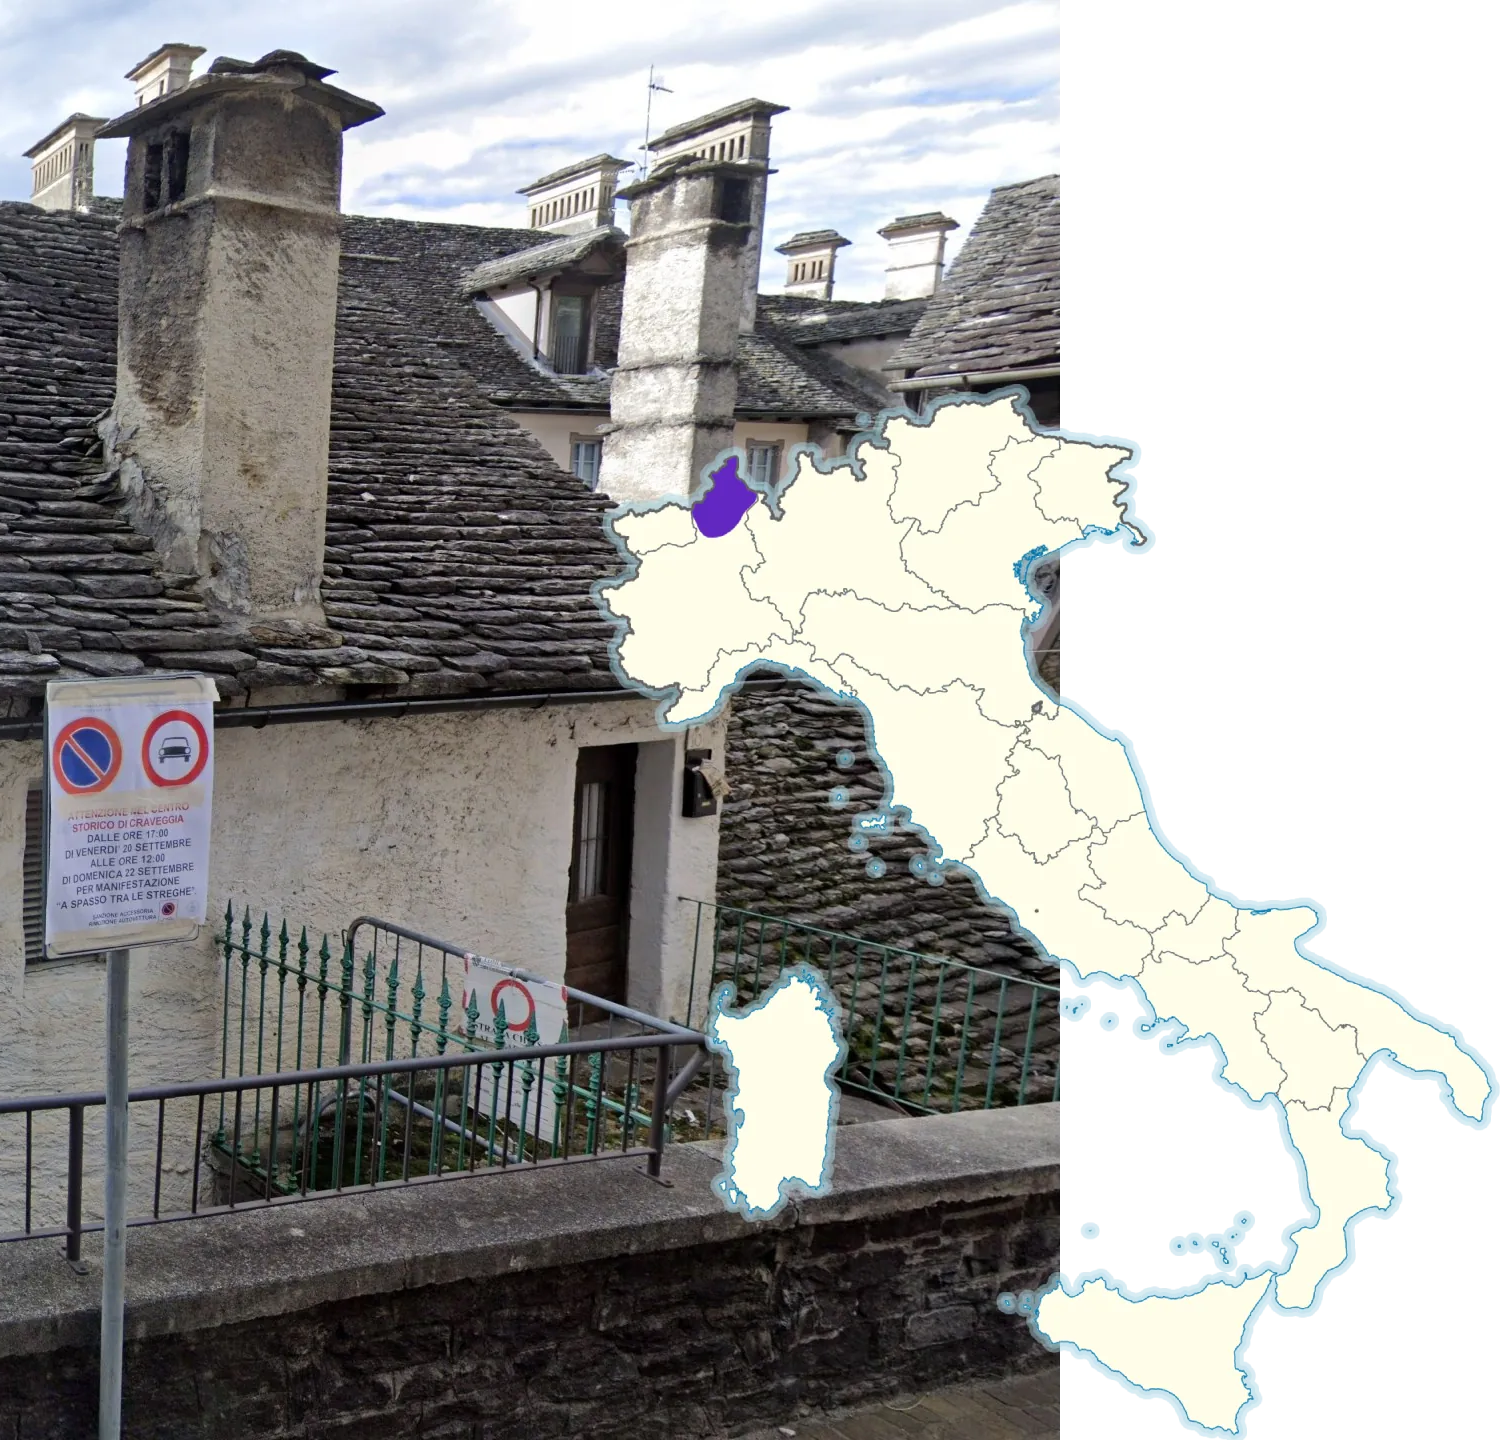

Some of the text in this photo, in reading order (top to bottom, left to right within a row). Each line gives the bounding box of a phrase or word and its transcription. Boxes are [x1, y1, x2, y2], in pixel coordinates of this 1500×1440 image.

[68, 807, 127, 821] ATTENZIONE
[72, 814, 184, 833] STORICO DI CRAVEGGIA
[87, 829, 168, 843] DALLE ORE 17:00
[65, 850, 73, 859] DI
[123, 844, 132, 853] 20
[136, 838, 191, 851] SETTEMBRE
[91, 854, 165, 867] ALLE ORE 12:00
[62, 863, 194, 885] DI DOMENICA 22 SETTEMBRE
[76, 877, 180, 895] PER MANIFESTAZIONE
[71, 895, 107, 908] SPASSO
[111, 894, 129, 903] TRA
[132, 892, 143, 901] LE
[474, 1022, 510, 1039] TRAA
